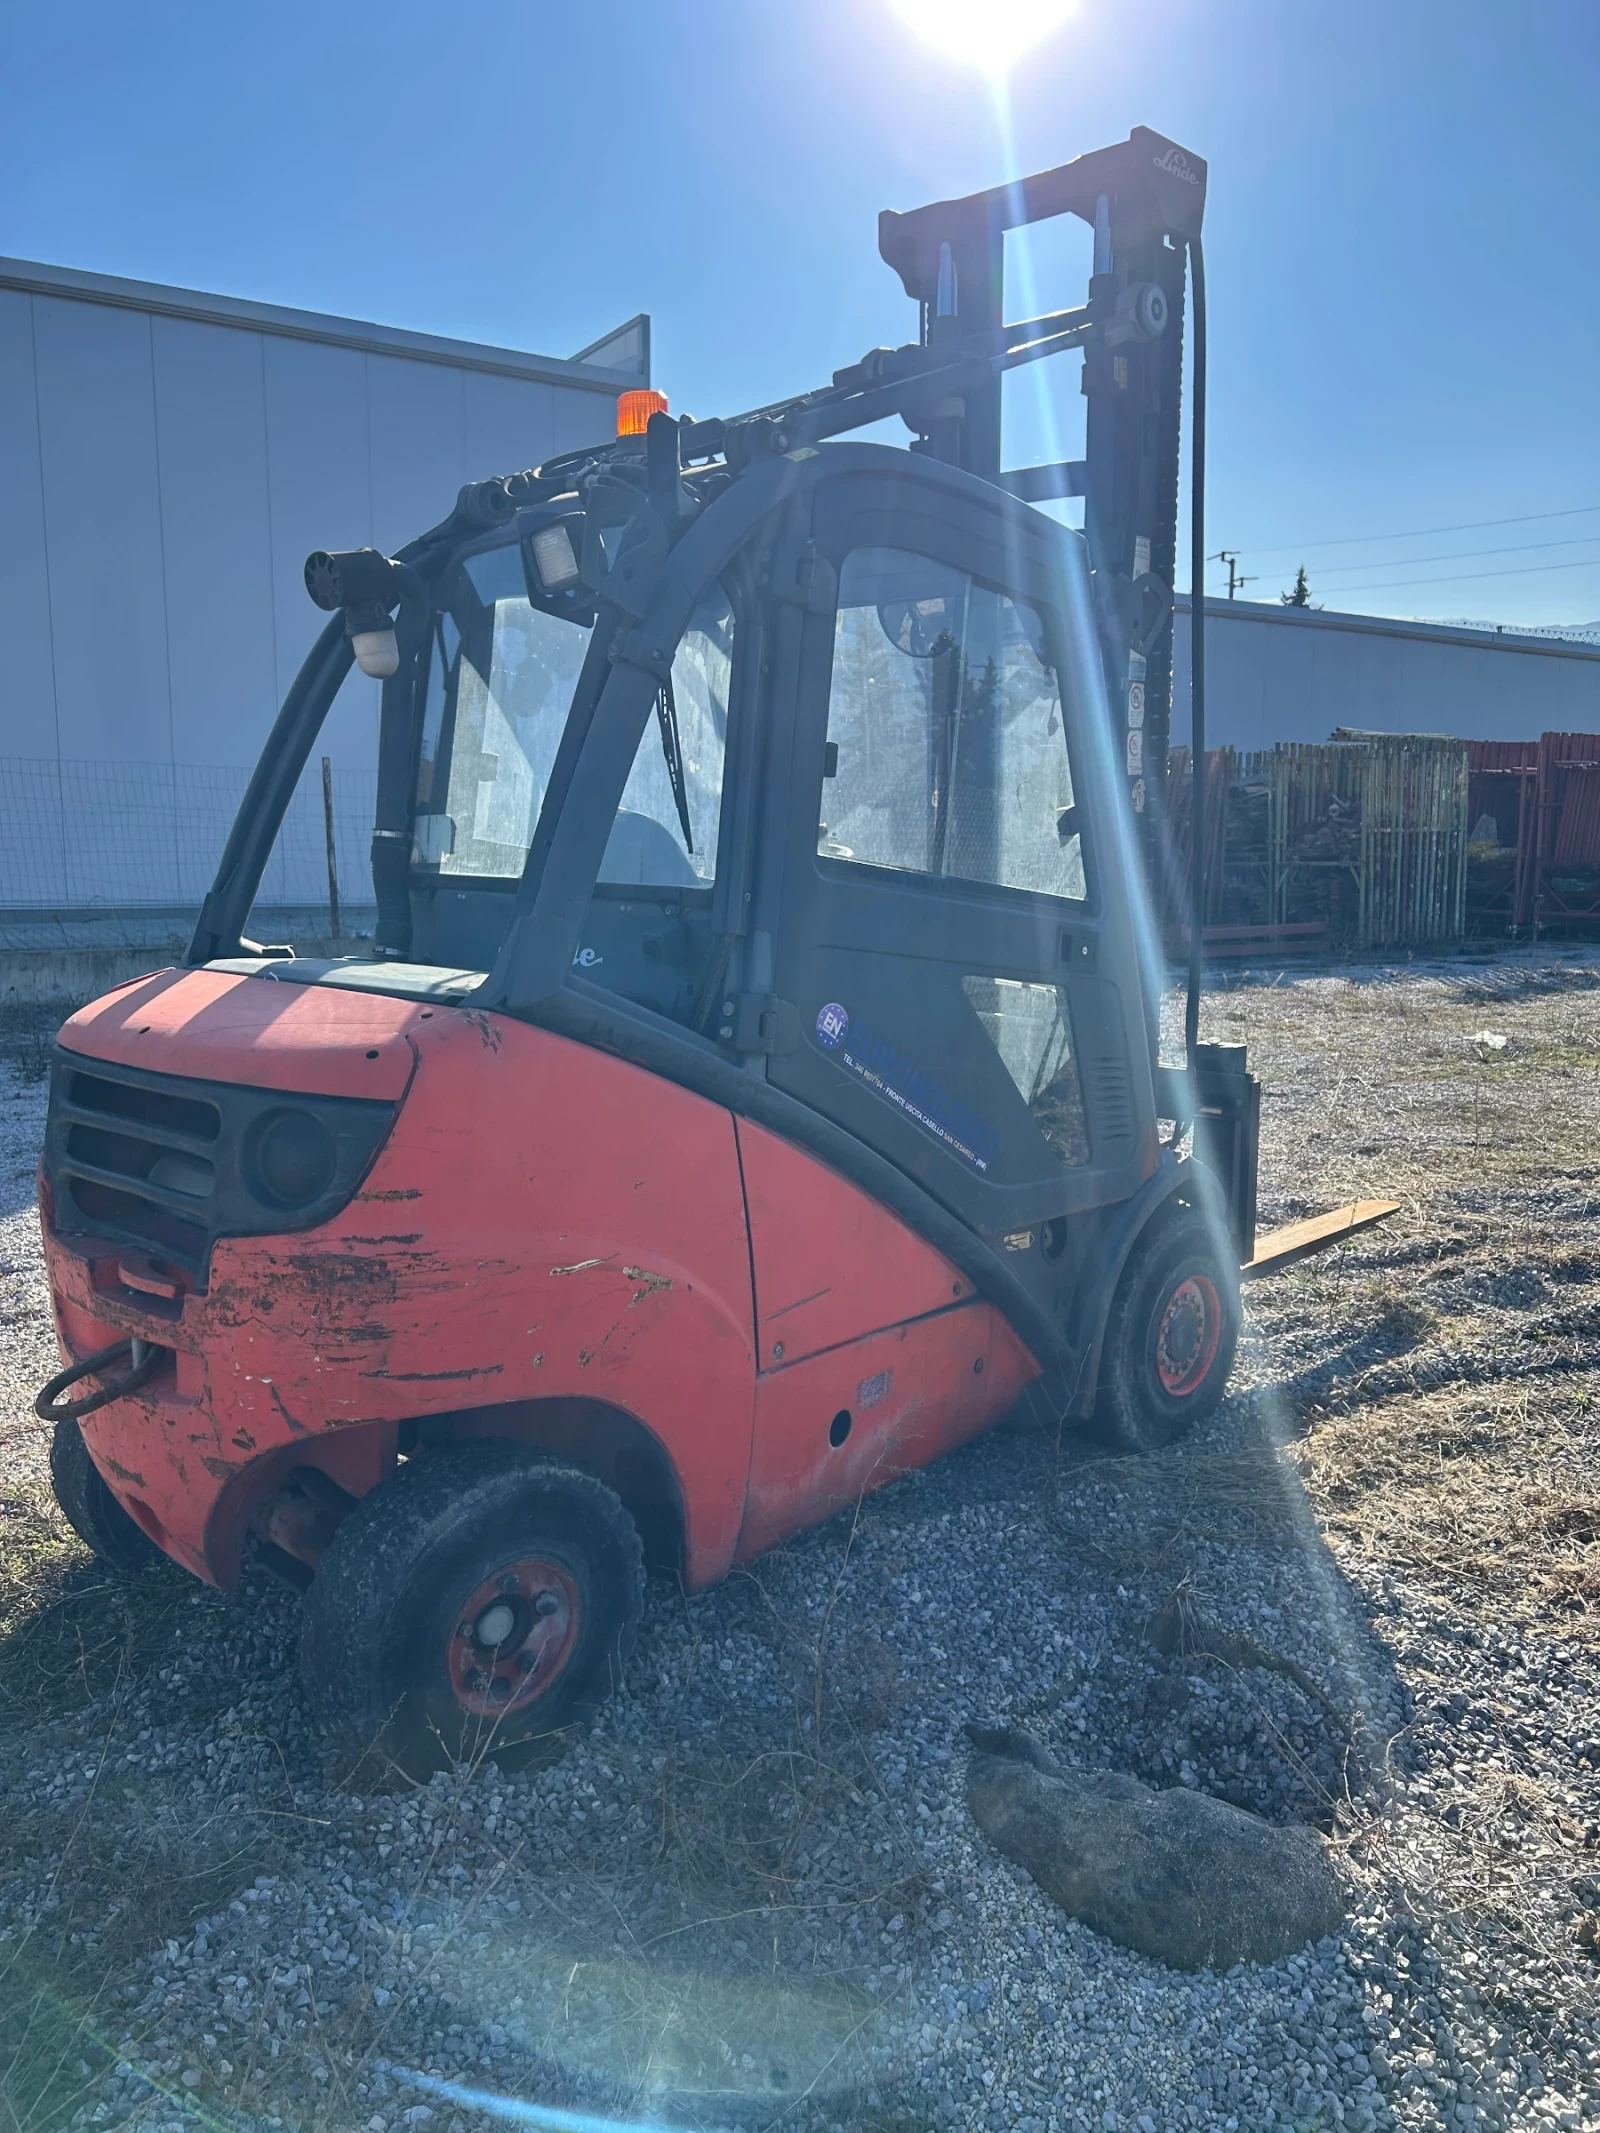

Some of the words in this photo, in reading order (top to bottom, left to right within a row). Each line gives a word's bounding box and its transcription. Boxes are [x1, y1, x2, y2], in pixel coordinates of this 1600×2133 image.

[1153, 149, 1200, 184] Linde
[823, 1011, 843, 1037] EN
[885, 1086, 906, 1107] FRONTE
[905, 1102, 922, 1121] USCITA
[922, 1115, 944, 1137] CASELLO
[943, 1132, 954, 1144] SAN
